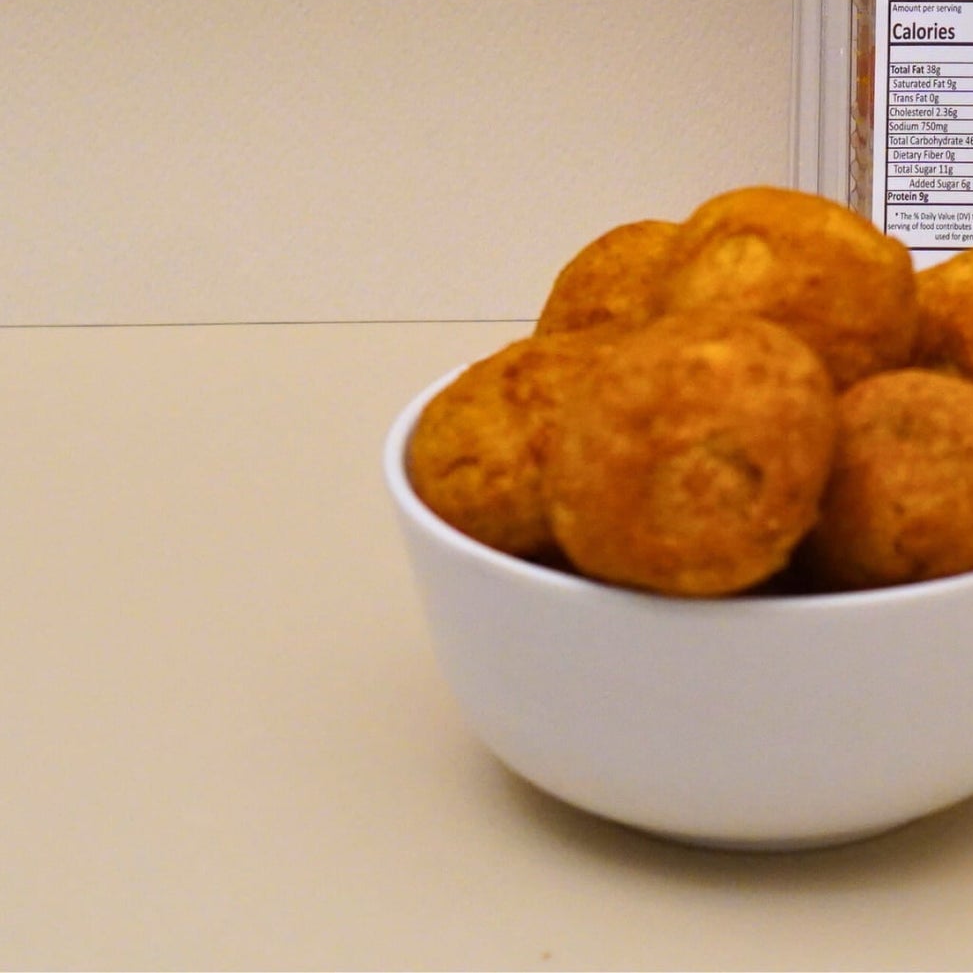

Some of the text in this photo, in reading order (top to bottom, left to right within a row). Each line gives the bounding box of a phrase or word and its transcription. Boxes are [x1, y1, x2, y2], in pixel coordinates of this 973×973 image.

[923, 6, 934, 14] per
[937, 5, 962, 14] serving
[893, 23, 955, 40] Calories
[890, 66, 941, 76] Total Fat 38g
[893, 80, 956, 90] Saturated Fat 9g
[893, 94, 939, 104] Trans Fat 0g
[890, 108, 958, 119] Cholesterol 2.36g
[889, 123, 948, 133] Sodium 750mg
[890, 137, 908, 145] Total
[910, 137, 963, 147] Carbohydrate
[893, 151, 955, 161] Dietary Fiber 0g
[894, 165, 953, 175] Total Sugar 11g
[910, 180, 971, 190] Added Sugar 6g
[888, 193, 929, 203] Protein 9g
